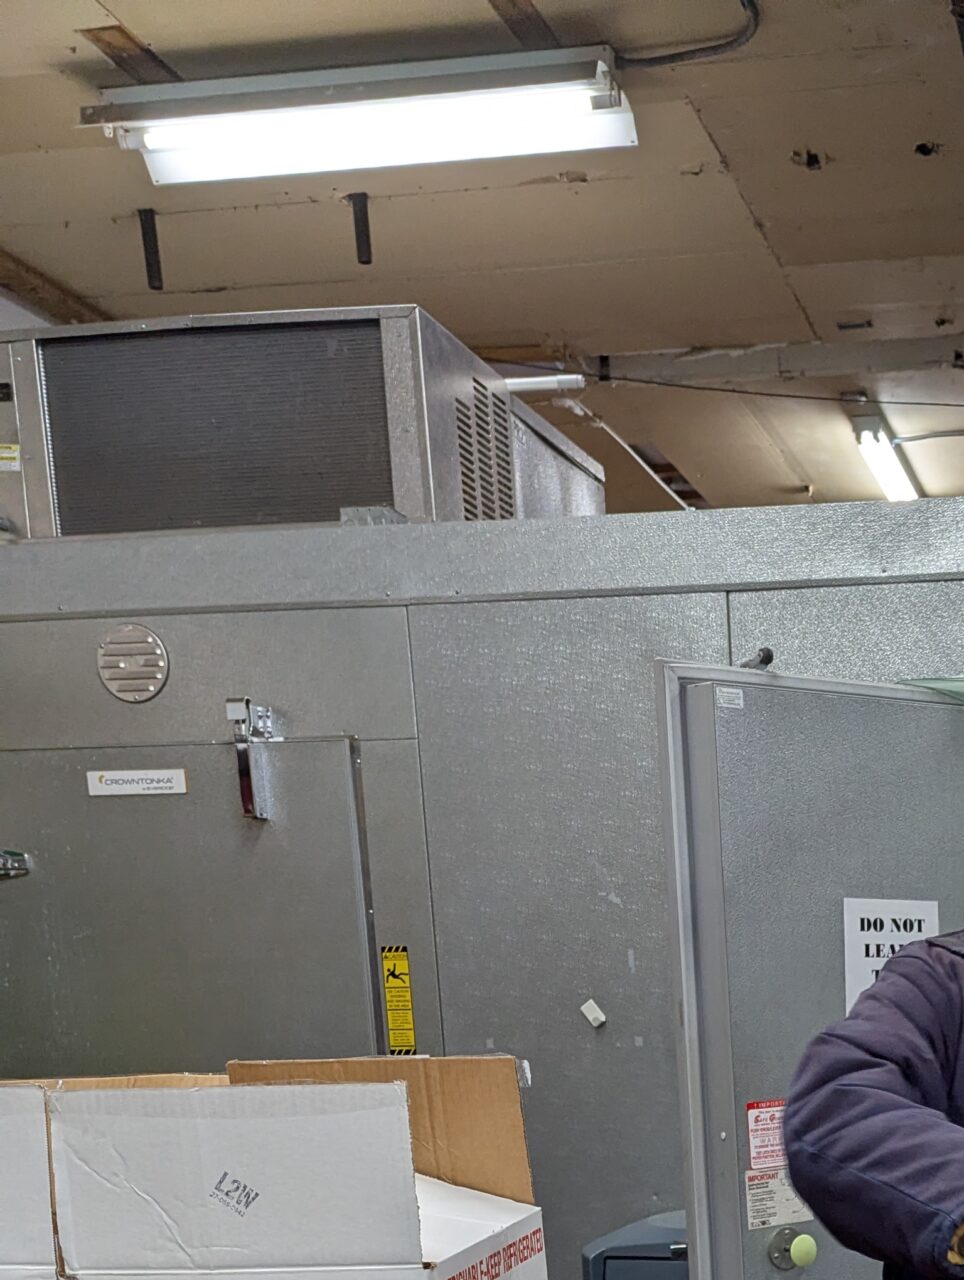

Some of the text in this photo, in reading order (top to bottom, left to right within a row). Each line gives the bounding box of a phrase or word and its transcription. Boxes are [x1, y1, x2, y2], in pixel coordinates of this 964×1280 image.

[104, 776, 174, 786] CROWNTONKA
[860, 917, 926, 933] DO NOT
[864, 943, 904, 958] LEA
[748, 1172, 779, 1183] IMPORTANT
[214, 1171, 259, 1210] L2W
[503, 1227, 543, 1274] REFRIGERATED
